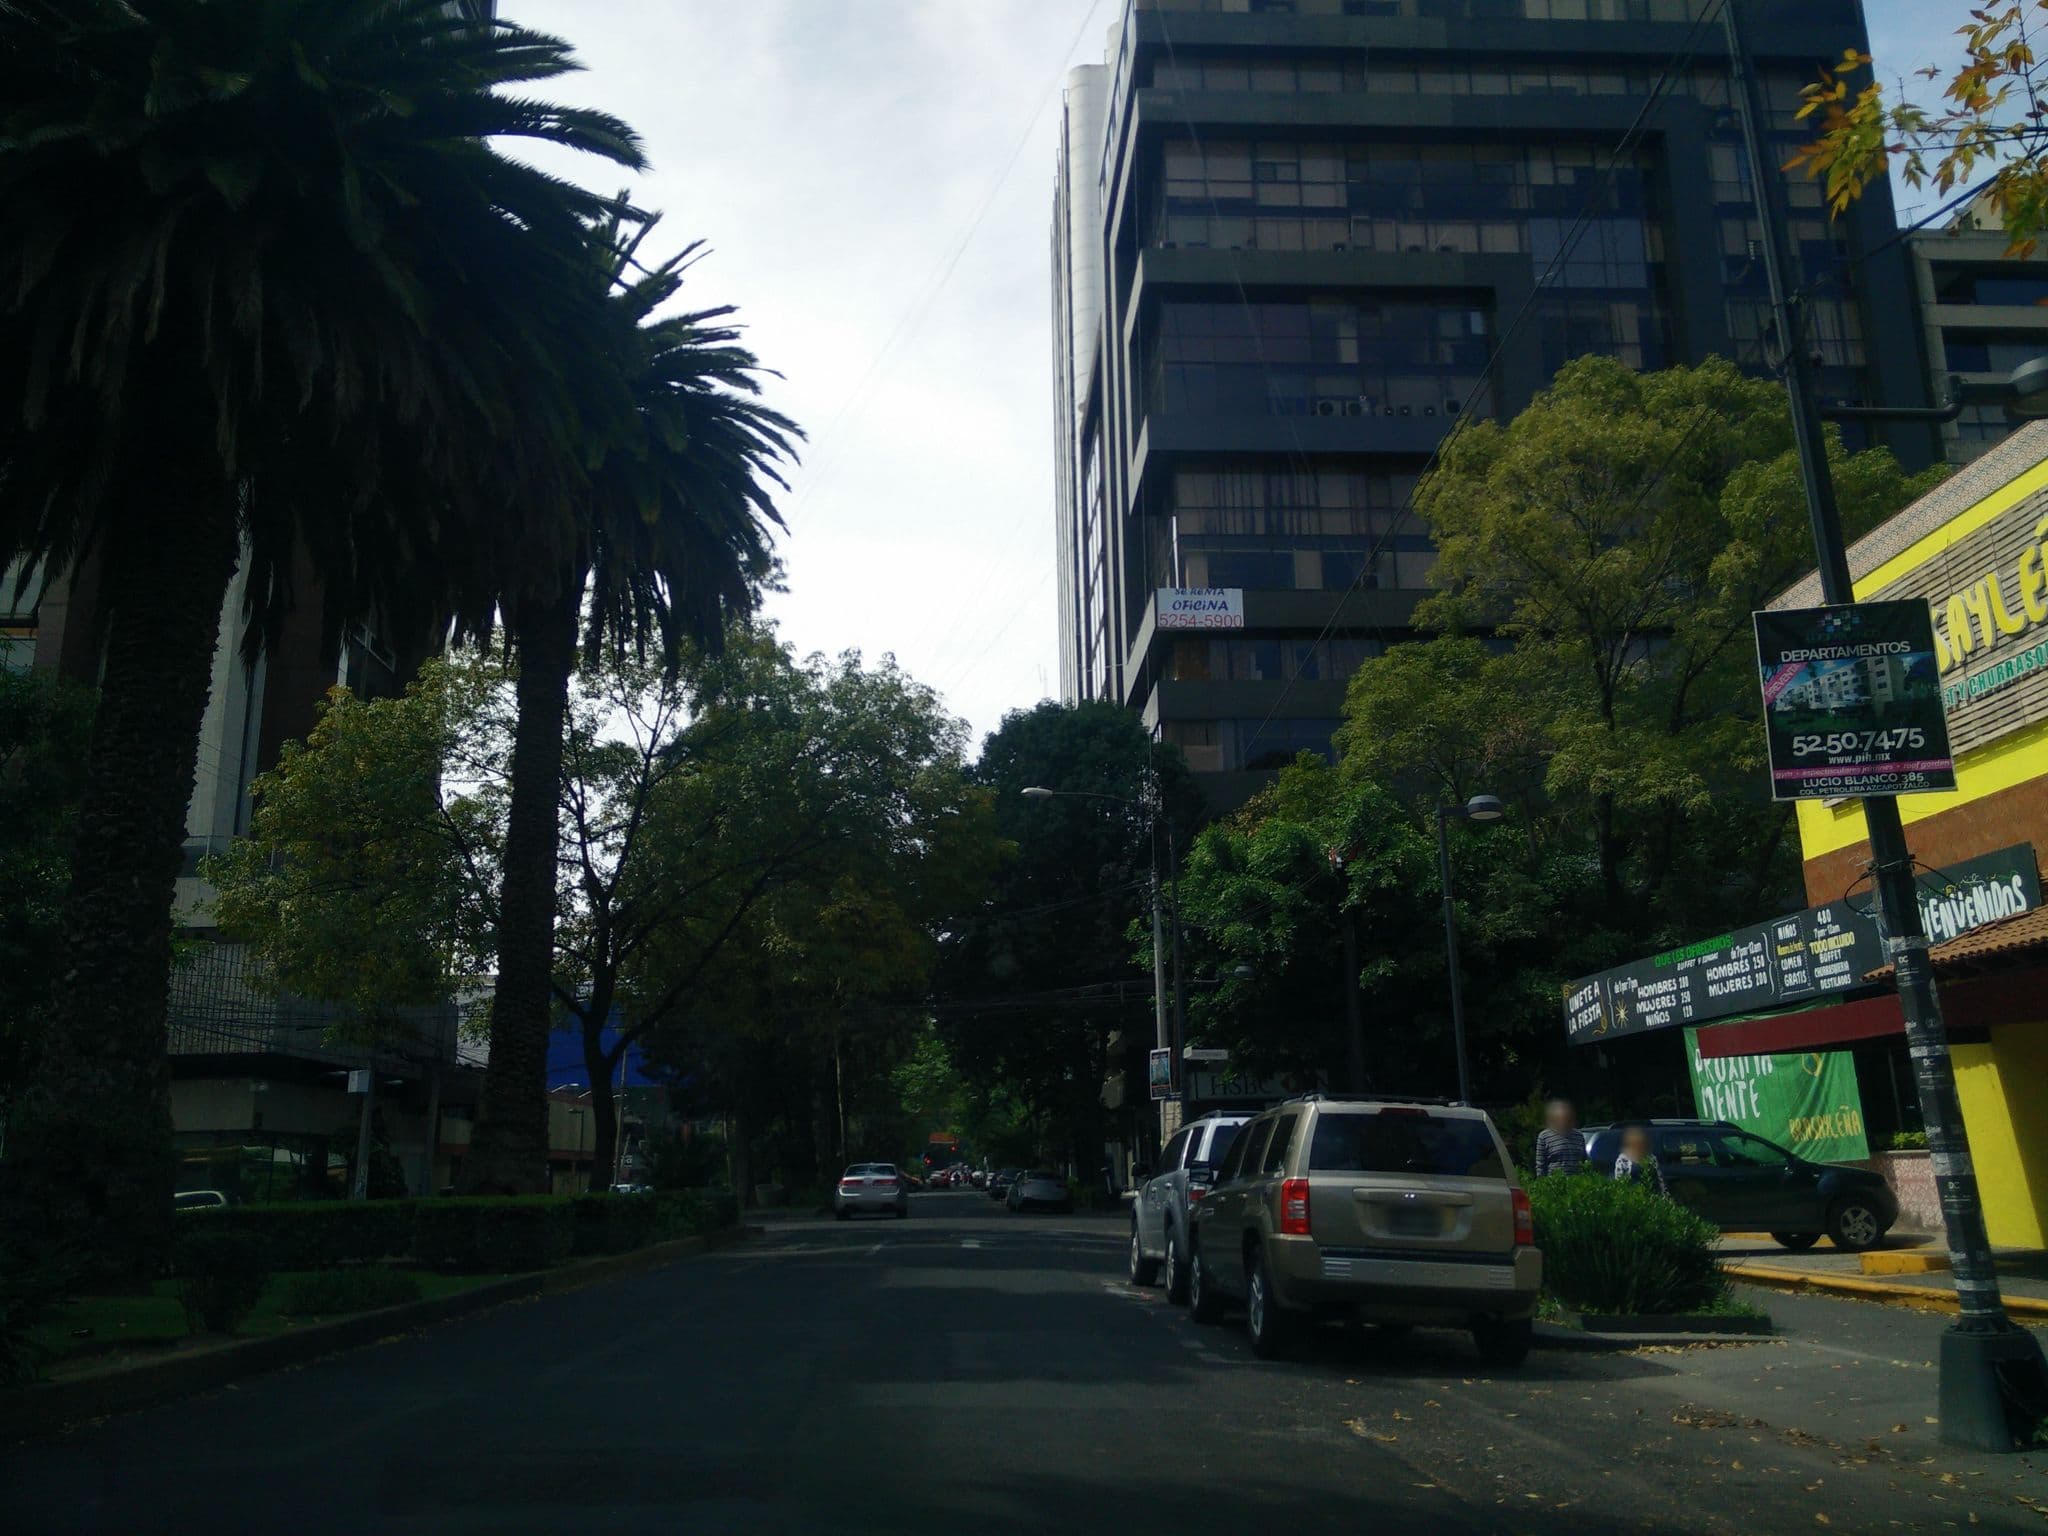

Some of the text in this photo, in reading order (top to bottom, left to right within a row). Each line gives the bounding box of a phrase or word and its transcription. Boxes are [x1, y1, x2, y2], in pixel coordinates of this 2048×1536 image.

[1932, 513, 2048, 673] AYLE
[1159, 613, 1243, 629] 5254-5900
[1780, 640, 1912, 663] DEPARTAMENTOS
[1802, 771, 1924, 788] LUCIO BLANCO 385
[1818, 784, 1866, 795] PETROLERA
[1706, 958, 1750, 982] HOMBRES
[1780, 954, 1802, 971] COMEN
[1637, 977, 1678, 999] HOMBRES
[1708, 974, 1753, 998] MUJERES
[1783, 969, 1807, 987] GRATIS
[1636, 994, 1677, 1014] MUJERES
[1568, 1001, 1602, 1035] LA FIESTA
[1645, 1010, 1671, 1027] NIÑOS
[1701, 1077, 1761, 1121] MENTE
